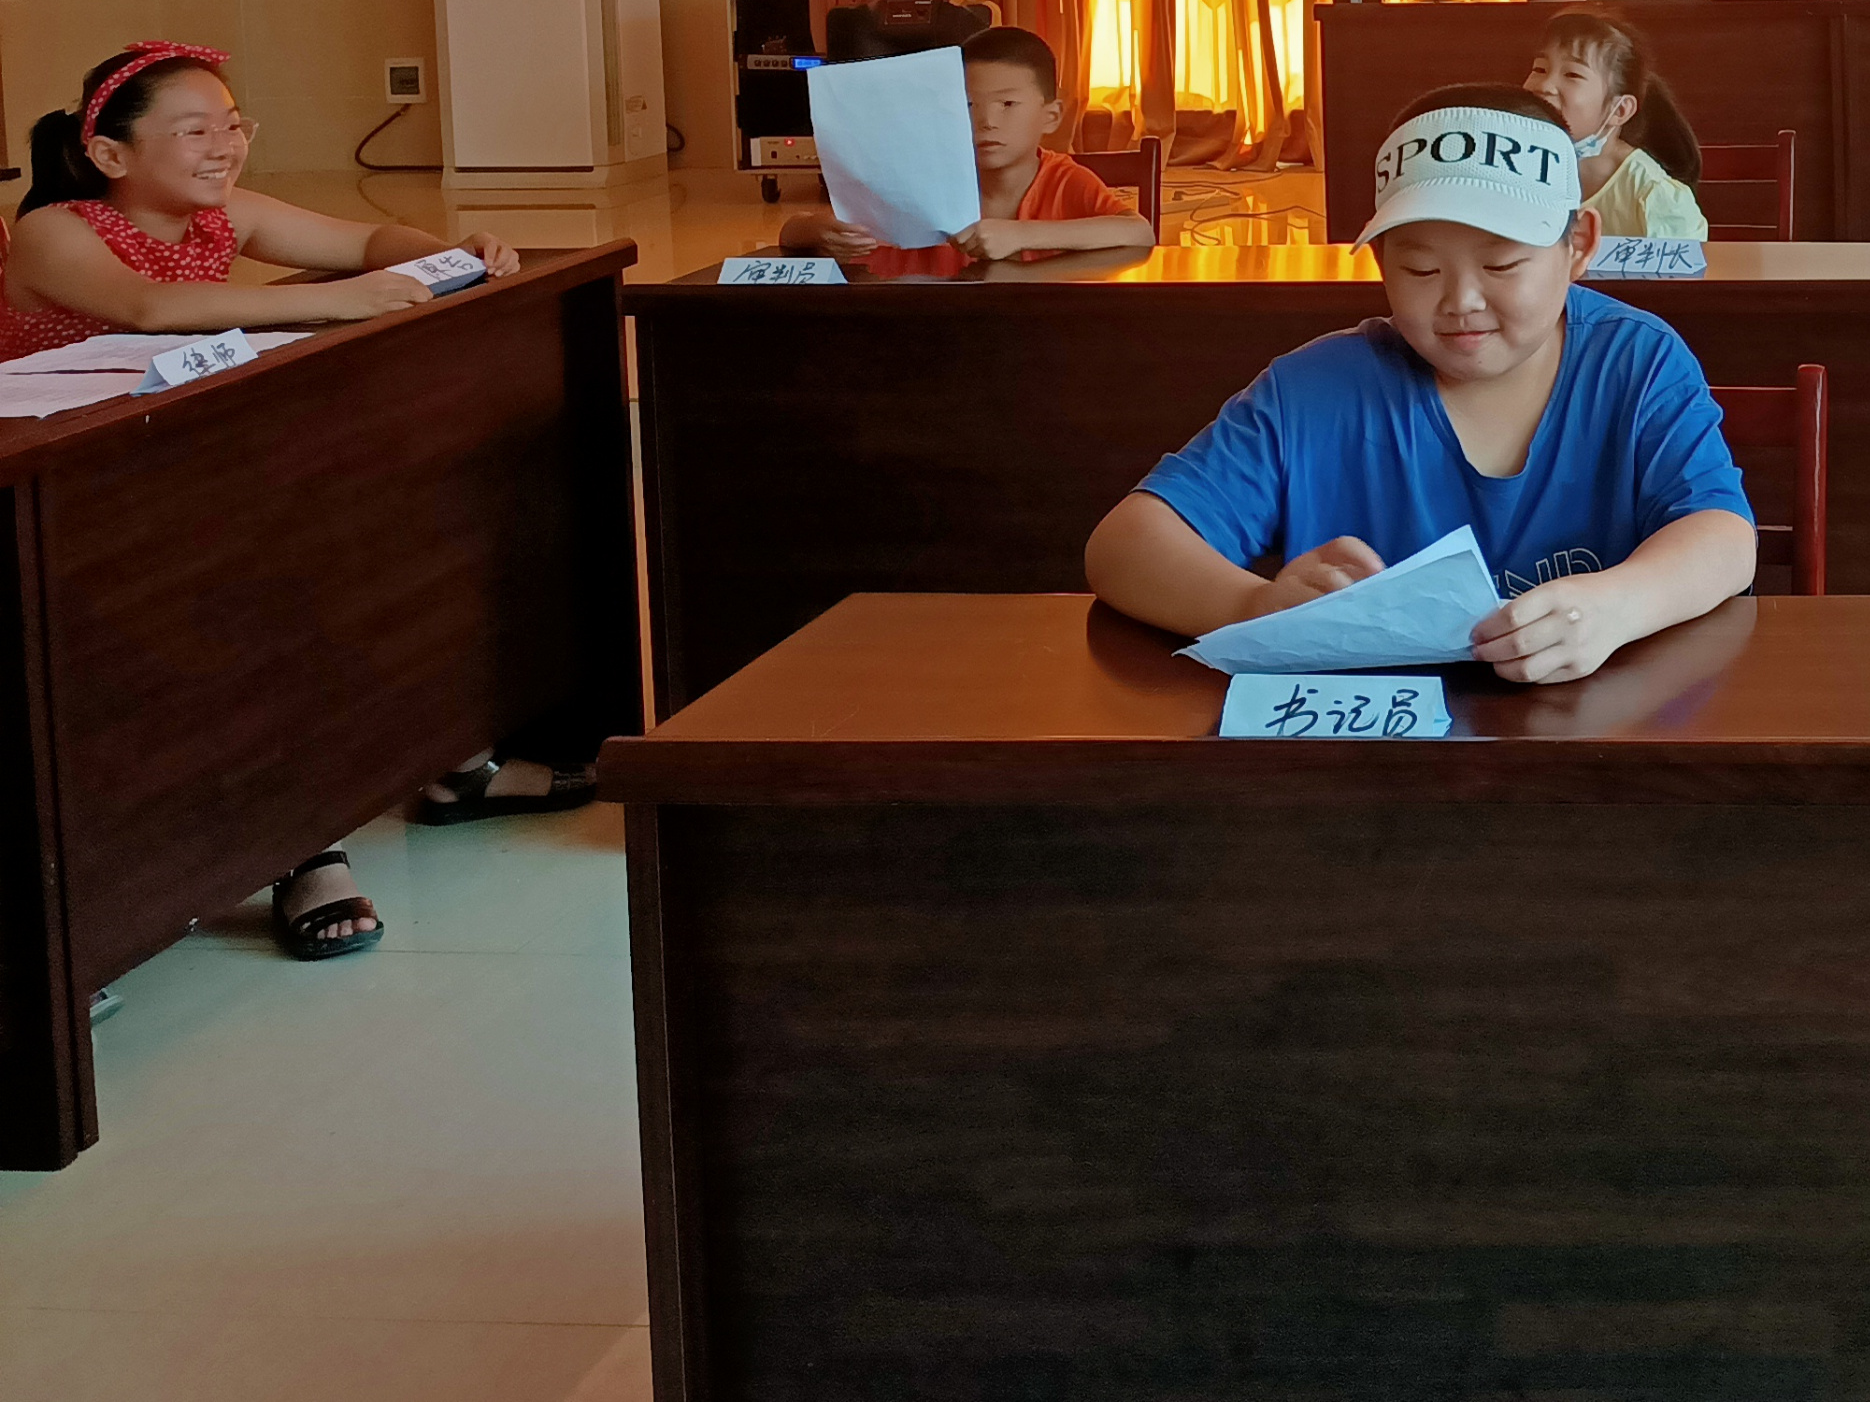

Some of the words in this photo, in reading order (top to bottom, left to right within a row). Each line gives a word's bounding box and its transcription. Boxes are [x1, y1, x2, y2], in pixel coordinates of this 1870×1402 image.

[1376, 130, 1561, 194] SPORT
[732, 260, 816, 284] 审判员
[1597, 237, 1693, 274] 审判长
[181, 342, 236, 377] 律师
[1264, 682, 1420, 737] 书记员
